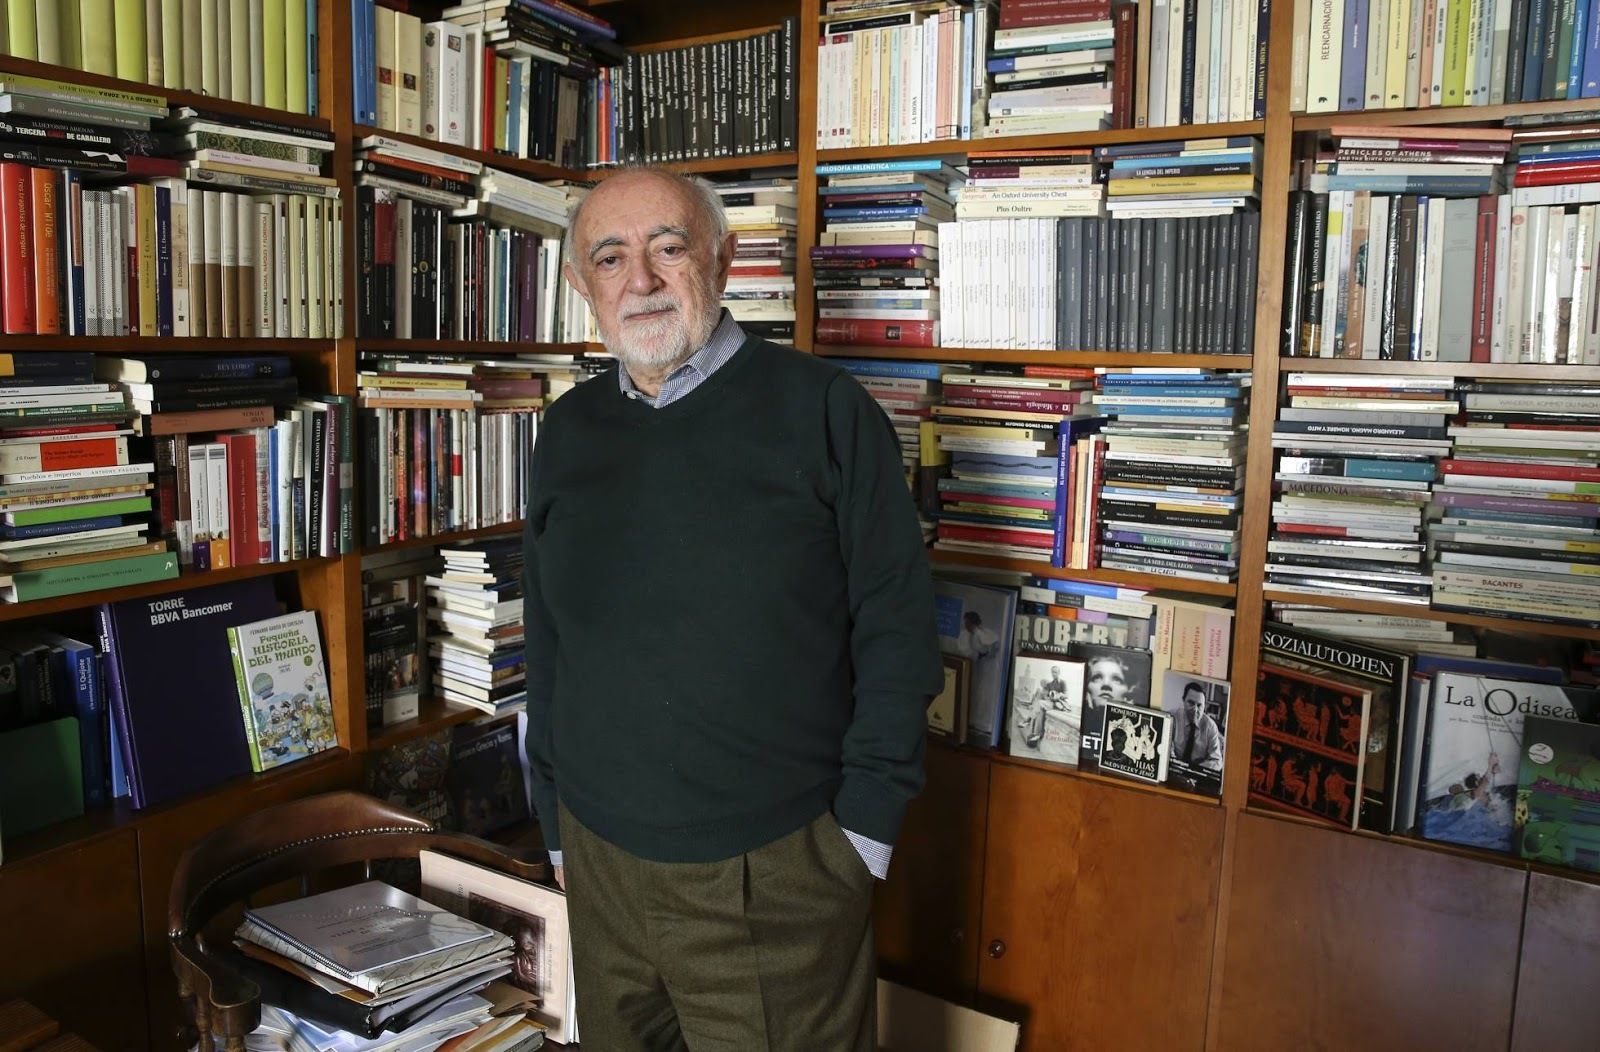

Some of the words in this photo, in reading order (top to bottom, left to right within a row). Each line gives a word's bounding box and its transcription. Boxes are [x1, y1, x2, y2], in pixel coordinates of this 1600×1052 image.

[786, 39, 791, 47] de
[911, 116, 917, 125] LA
[15, 127, 46, 136] TERCERA
[66, 133, 75, 141] DE
[76, 134, 111, 144] CABALLERO
[821, 164, 851, 172] FILOSOFÍA
[852, 163, 889, 171] HELENÍSTICA
[44, 183, 53, 207] Oscar
[1314, 239, 1320, 247] DE
[1026, 402, 1053, 410] Mitología
[1307, 424, 1322, 433] MITO
[1326, 426, 1350, 434] HOMBRE
[1373, 428, 1406, 436] ALEJANDRO
[20, 473, 47, 482] Pueblos
[54, 471, 81, 479] imperios
[1288, 483, 1349, 496] MACEDONIA
[1482, 579, 1523, 589] BACANTES
[148, 597, 185, 613] TORRE
[150, 612, 180, 626] BBVA
[182, 602, 233, 620] Bancomer
[1015, 615, 1128, 648] ROBERT
[253, 635, 309, 655] HISTORIA
[1021, 641, 1040, 651] UNA
[1191, 626, 1201, 666] Completas
[248, 655, 272, 668] DEL
[275, 644, 316, 662] MUNDO
[1263, 631, 1394, 677] SOZIALUTOPIEN
[79, 658, 87, 683] Quijote
[1444, 685, 1475, 707] La
[1484, 688, 1577, 720] Odisea
[1111, 707, 1137, 718] HOMEROS
[1046, 735, 1073, 743] Cernuda
[1104, 760, 1139, 775] MEDVECZKY
[1135, 760, 1155, 772] ILIAS
